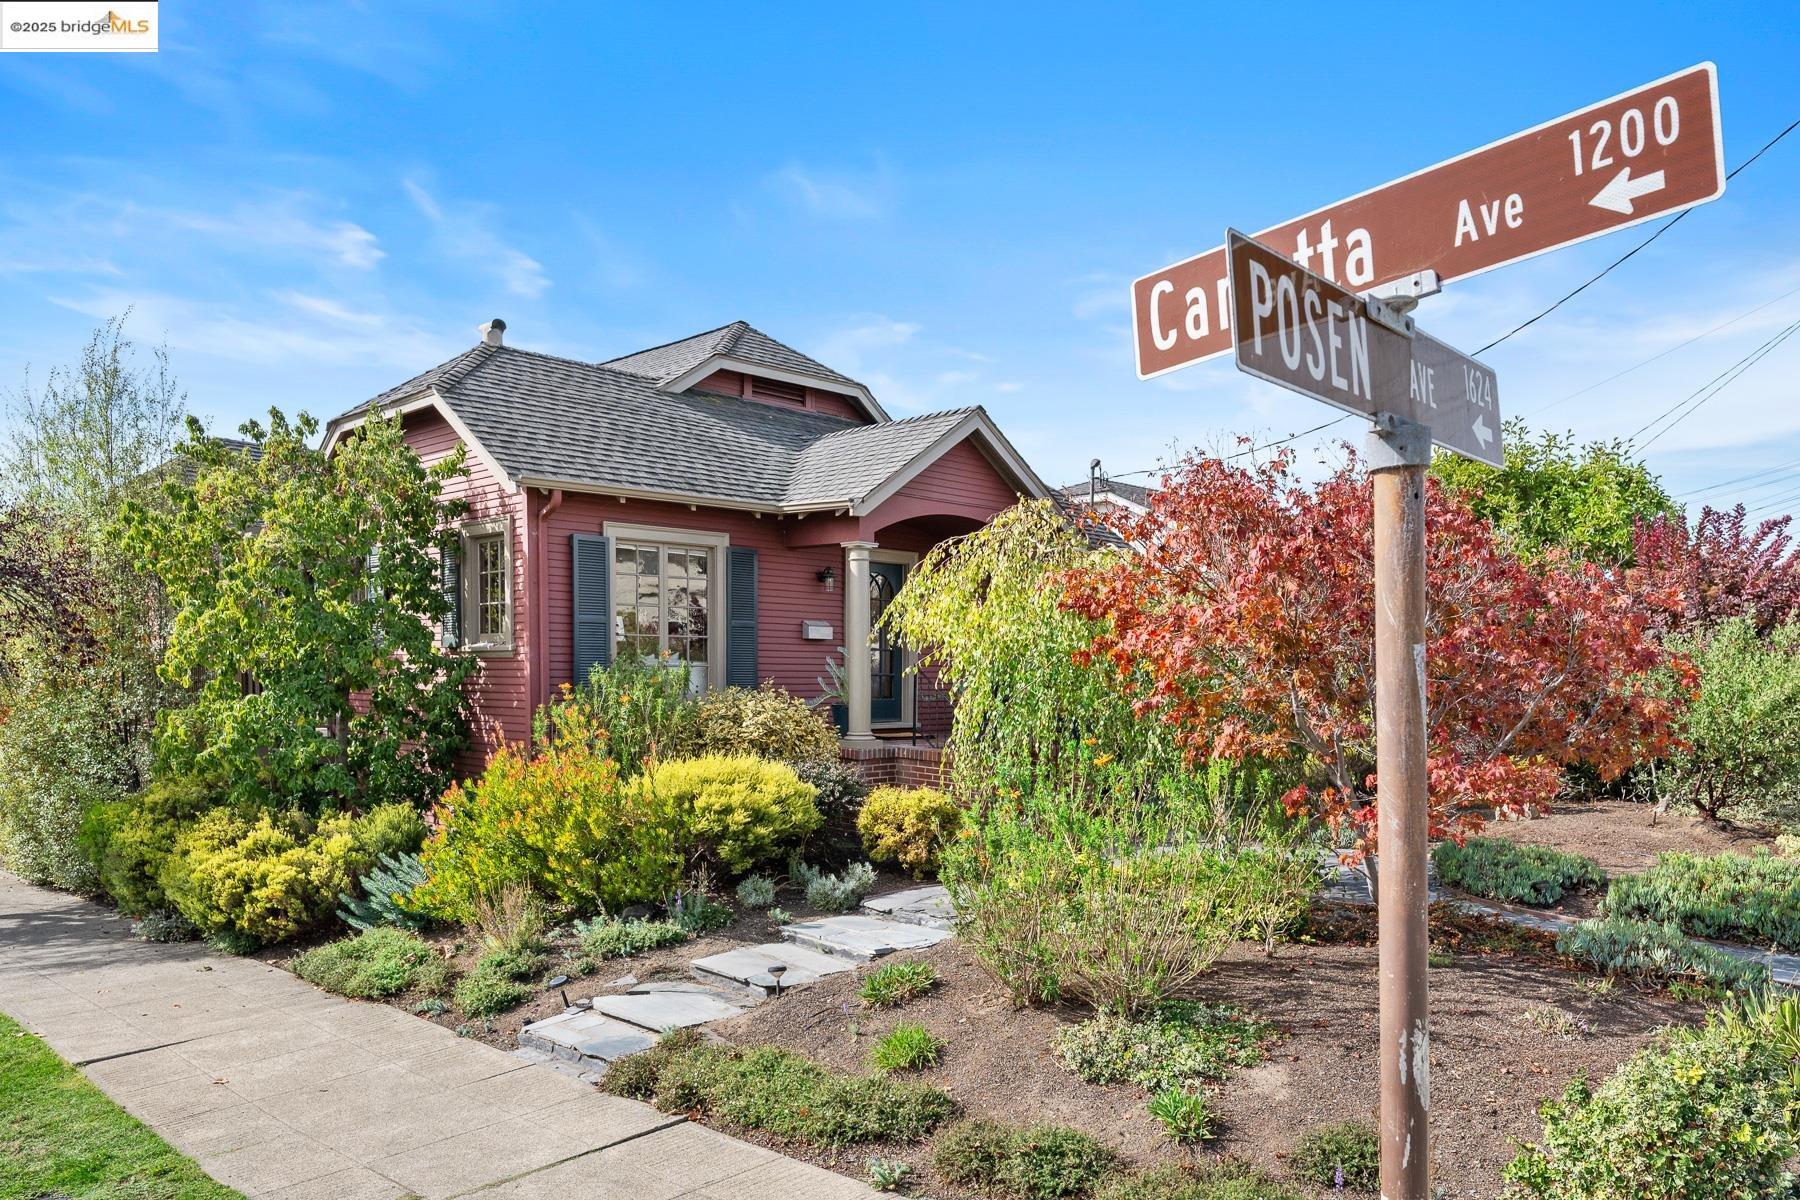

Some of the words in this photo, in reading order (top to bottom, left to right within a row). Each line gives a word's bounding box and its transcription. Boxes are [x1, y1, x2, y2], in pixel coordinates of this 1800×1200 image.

[1568, 96, 1680, 176] 1200
[1150, 219, 1375, 351] Cartta
[1454, 193, 1524, 248] Ave
[1249, 258, 1372, 401] POSEN
[1410, 359, 1437, 409] AVE
[1463, 364, 1492, 411] 1624
